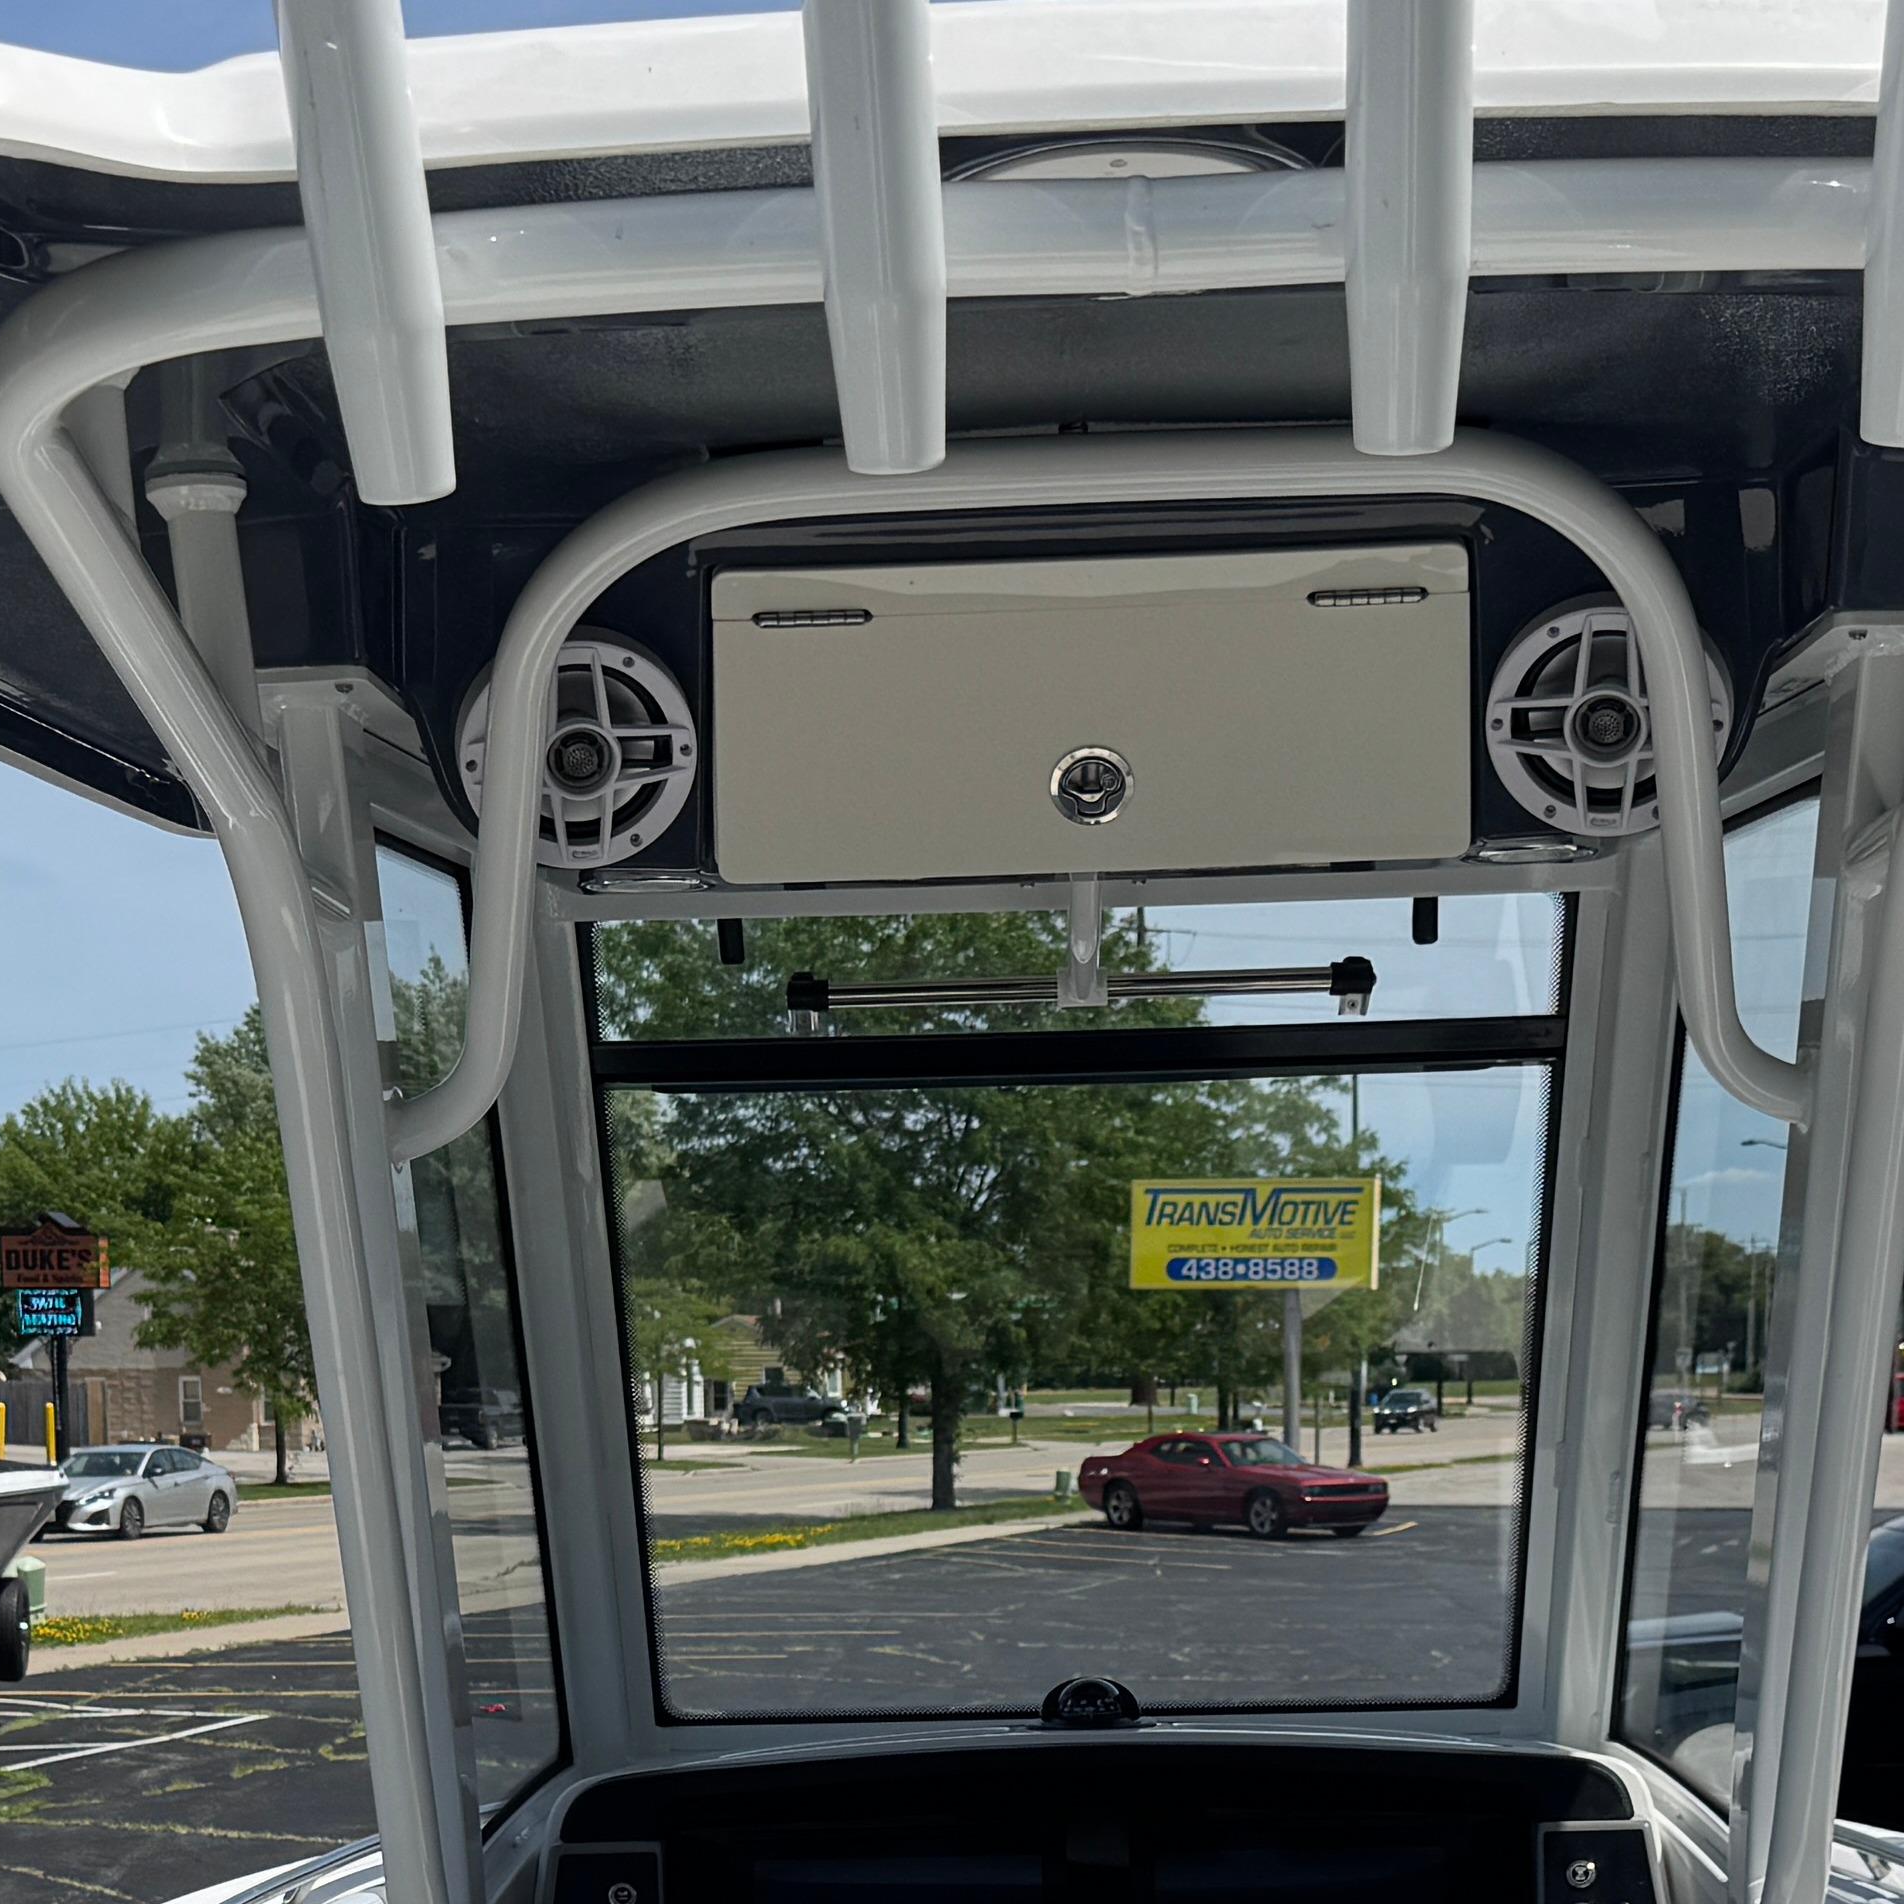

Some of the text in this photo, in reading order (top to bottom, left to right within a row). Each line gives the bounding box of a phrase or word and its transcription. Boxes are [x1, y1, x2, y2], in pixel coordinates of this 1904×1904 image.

[1249, 1227, 1282, 1240] AUTO
[1285, 1227, 1337, 1240] SERVICE
[5, 1248, 93, 1271] DUKE'S
